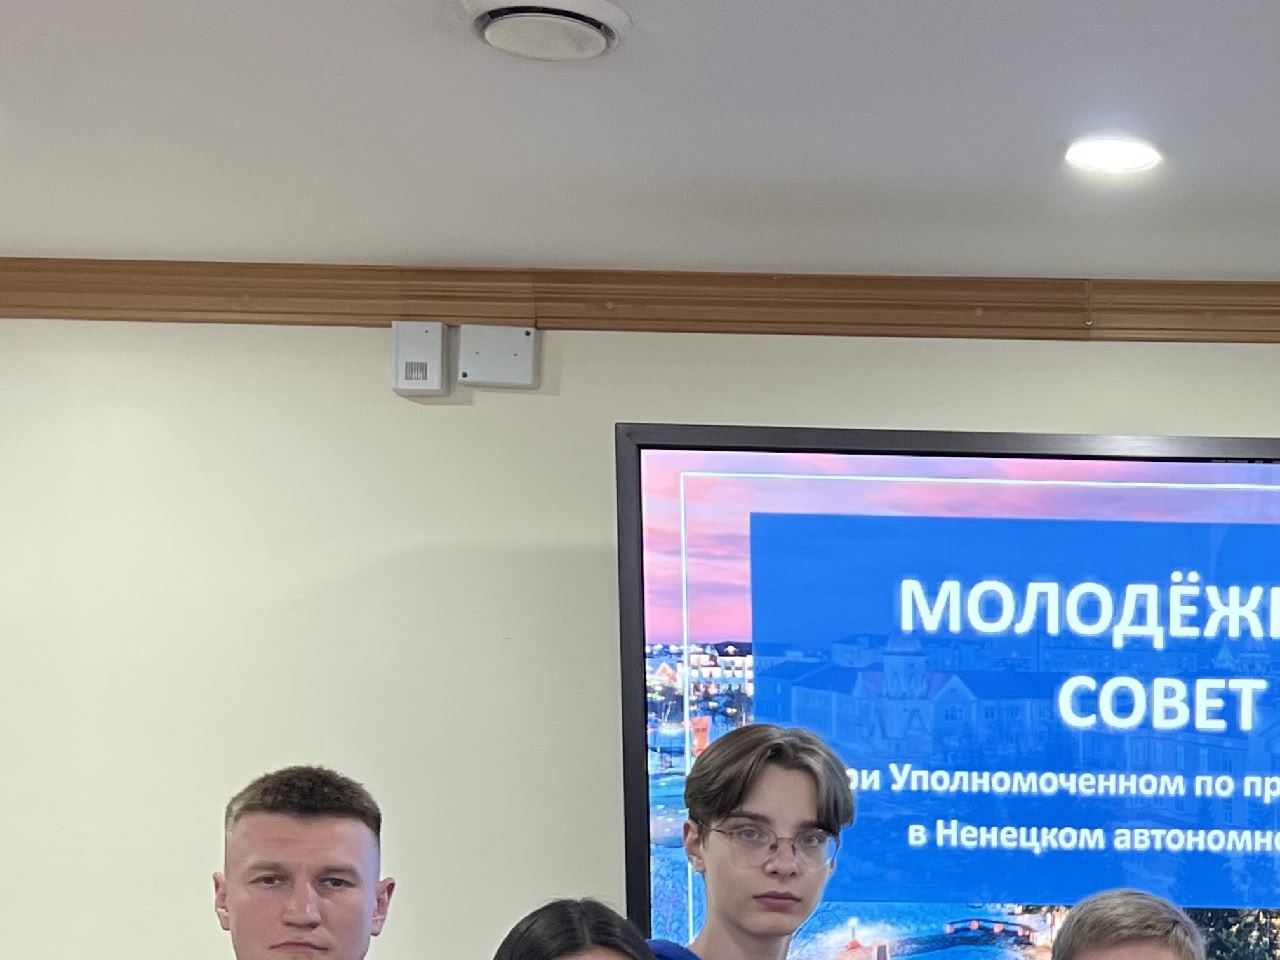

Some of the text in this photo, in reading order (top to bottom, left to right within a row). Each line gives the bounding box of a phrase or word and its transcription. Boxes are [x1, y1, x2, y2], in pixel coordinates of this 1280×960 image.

[1058, 675, 1268, 731] СОВЕТ
[889, 763, 1186, 795] Уполномоченном
[1195, 775, 1235, 797] по
[908, 823, 927, 846] в
[936, 819, 1105, 854] Ненецком
